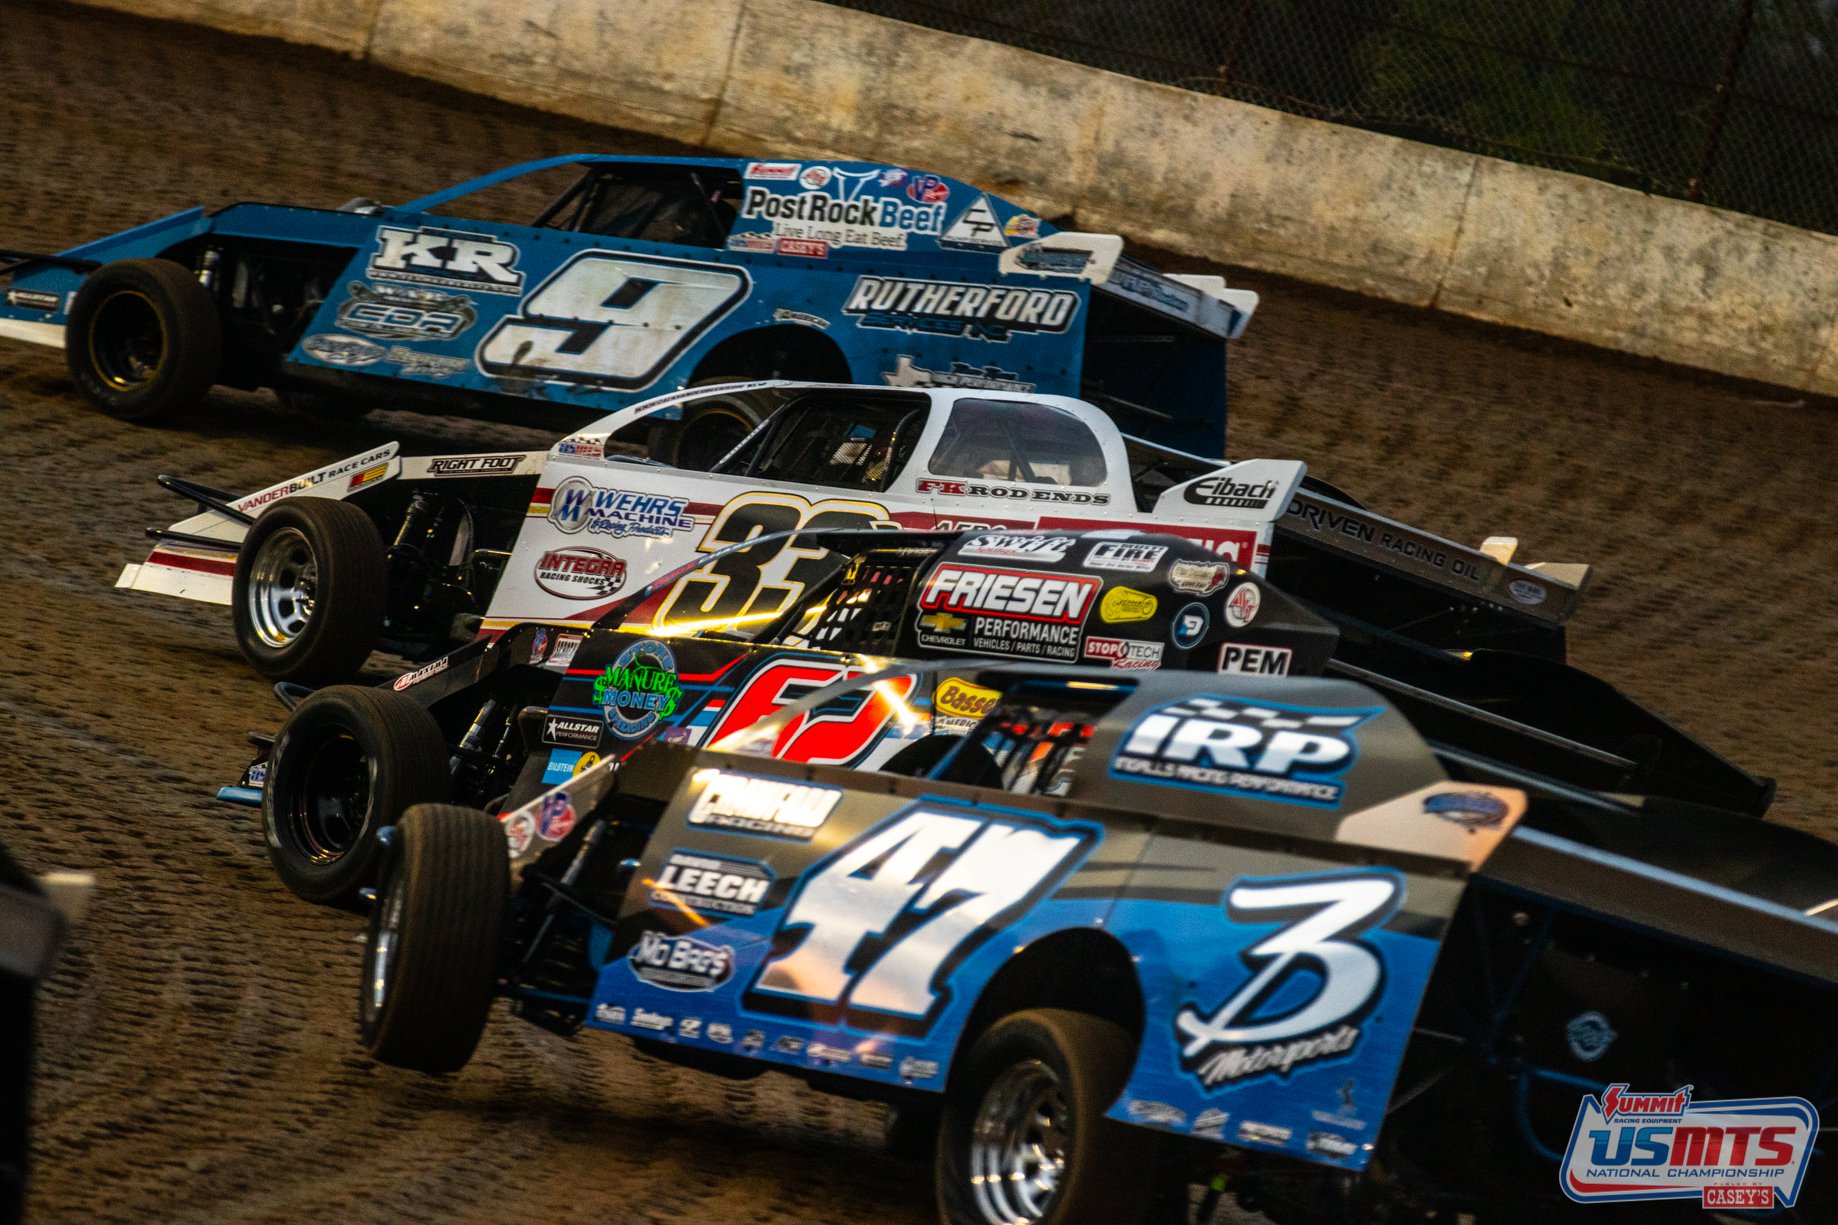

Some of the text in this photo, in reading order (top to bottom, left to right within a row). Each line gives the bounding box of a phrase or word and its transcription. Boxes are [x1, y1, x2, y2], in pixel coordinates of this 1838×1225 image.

[775, 223, 803, 237] Live
[808, 226, 841, 245] Long
[845, 229, 868, 244] Eat
[373, 230, 519, 283] KR
[849, 279, 1075, 326] RUTHERFORD
[482, 257, 743, 379] 9
[328, 462, 359, 478] RACE
[361, 449, 391, 466] CARS
[431, 456, 521, 471] RIGHT FOOT
[596, 491, 687, 517] WEHRS
[917, 480, 1109, 504] FK ROD ENDS
[1184, 477, 1277, 508] Eibach
[585, 508, 693, 528] MACHINE
[966, 534, 1076, 554] Swift
[1287, 500, 1480, 582] DRIVEN RACING OIL
[539, 551, 626, 577] INTEGRA
[540, 572, 605, 586] RACING SHOCKS
[925, 569, 1093, 619] FRIESEN
[922, 634, 966, 646] CHEVROLET
[974, 616, 1080, 645] PERFORMANCE
[973, 637, 1010, 651] VEHICLES
[1016, 642, 1041, 655] PARTS
[1046, 645, 1076, 658] RACING
[1222, 646, 1289, 674] PEM
[1112, 657, 1162, 671] Racing
[605, 666, 677, 692] MANURE
[602, 689, 671, 711] MONEY
[556, 731, 598, 741] PERFORMANCE
[557, 721, 600, 733] ALLSTAR
[1125, 713, 1350, 774] IRP
[547, 761, 575, 772] BILSTEIN
[657, 865, 770, 903] LEECH
[753, 811, 1081, 1016] 47
